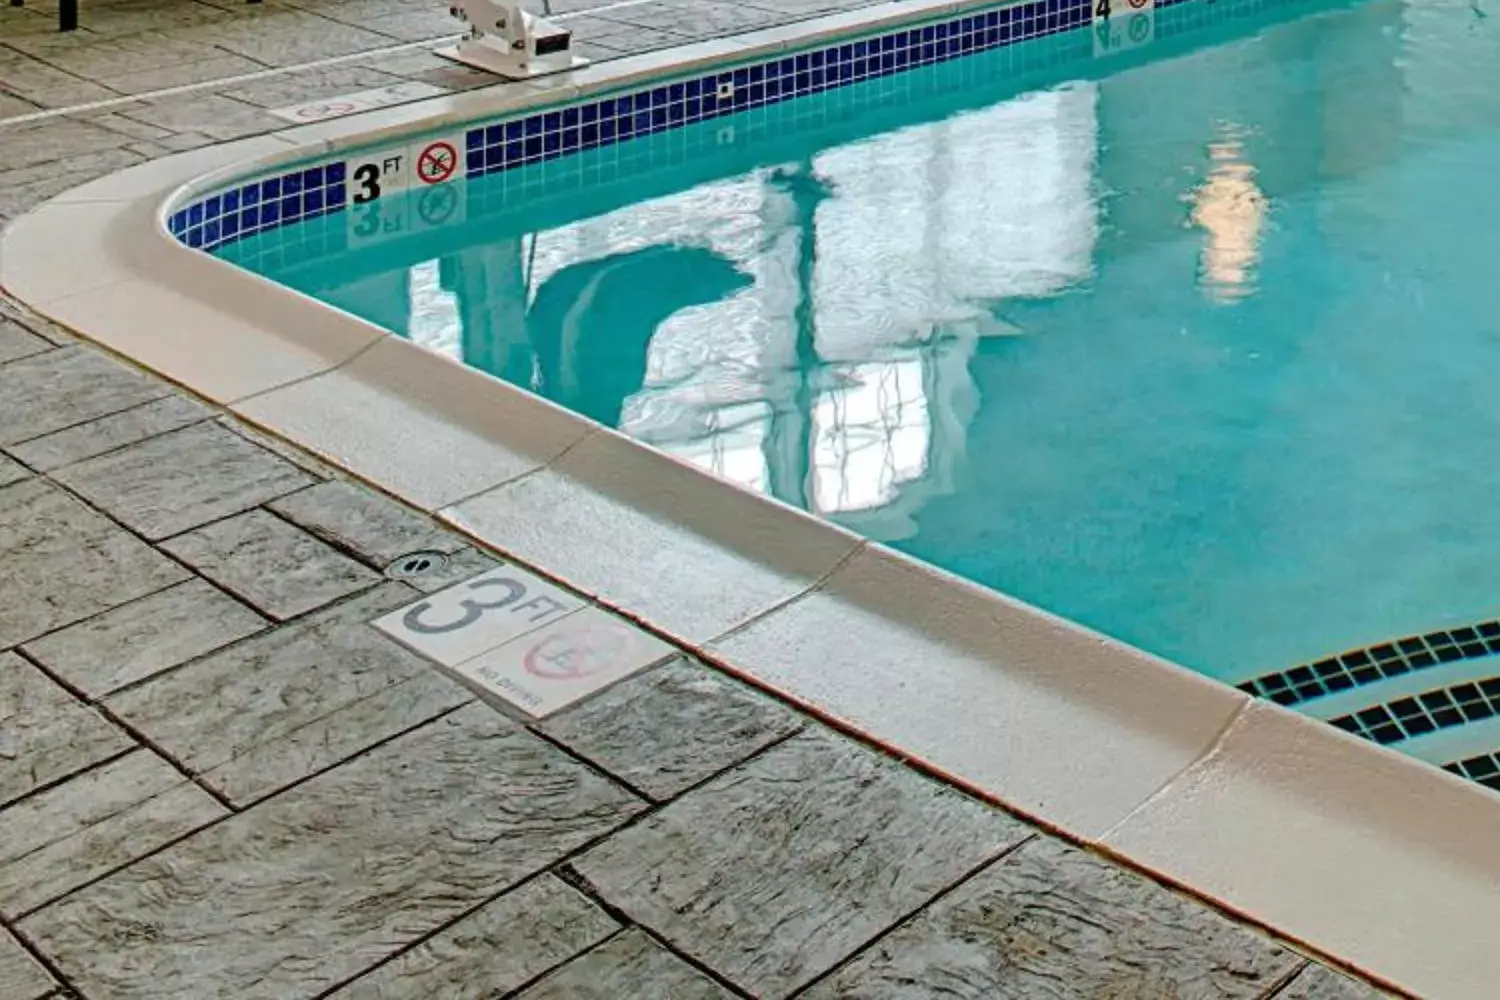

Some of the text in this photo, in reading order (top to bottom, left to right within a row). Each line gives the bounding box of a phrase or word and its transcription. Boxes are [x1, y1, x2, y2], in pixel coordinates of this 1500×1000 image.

[353, 155, 402, 204] 3 FT
[402, 576, 569, 635] 3 FT
